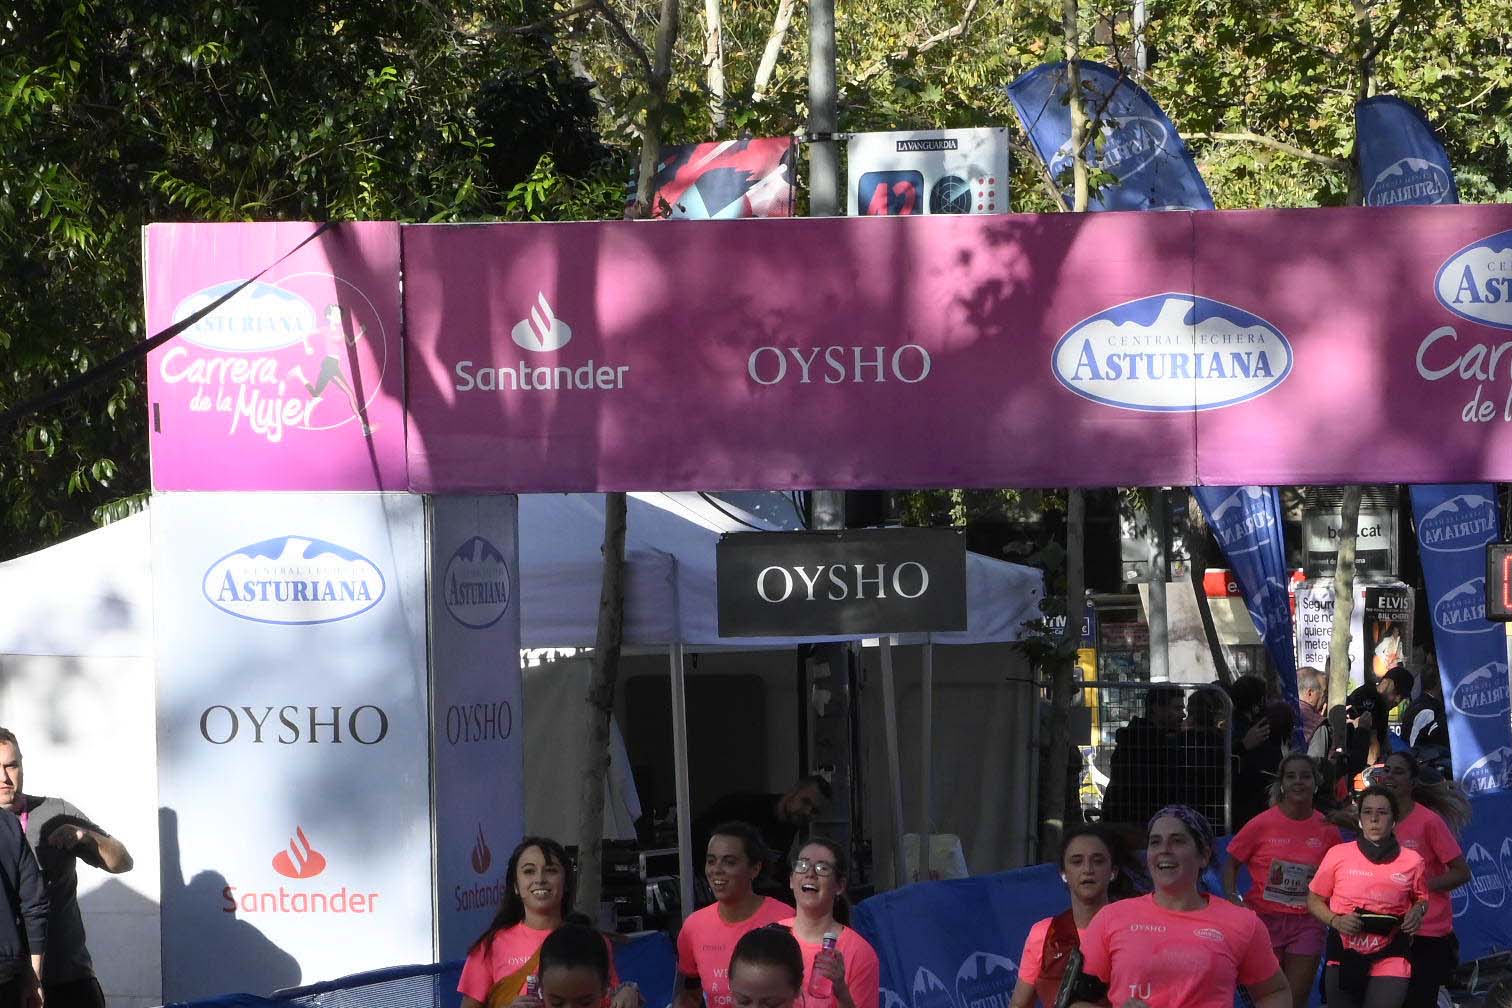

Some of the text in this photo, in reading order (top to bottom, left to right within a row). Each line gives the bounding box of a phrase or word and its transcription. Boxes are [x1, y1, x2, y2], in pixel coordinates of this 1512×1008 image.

[1108, 332, 1266, 347] CENTRAL LECHERA
[160, 346, 279, 385] Carrera
[455, 359, 630, 392] Santander
[747, 344, 932, 386] OYSHO
[1070, 338, 1275, 381] ASTURIANA
[190, 383, 324, 443] de la Mujer
[1461, 385, 1496, 423] de
[218, 568, 372, 603] ASTURIANA
[446, 571, 506, 609] ASTURIANA
[756, 560, 930, 604] OYSHO
[1378, 596, 1409, 609] ELVIS
[200, 704, 389, 745] OYSHO
[446, 700, 513, 746] OYSHO
[223, 886, 379, 914] Santander
[1129, 984, 1151, 1000] TU
